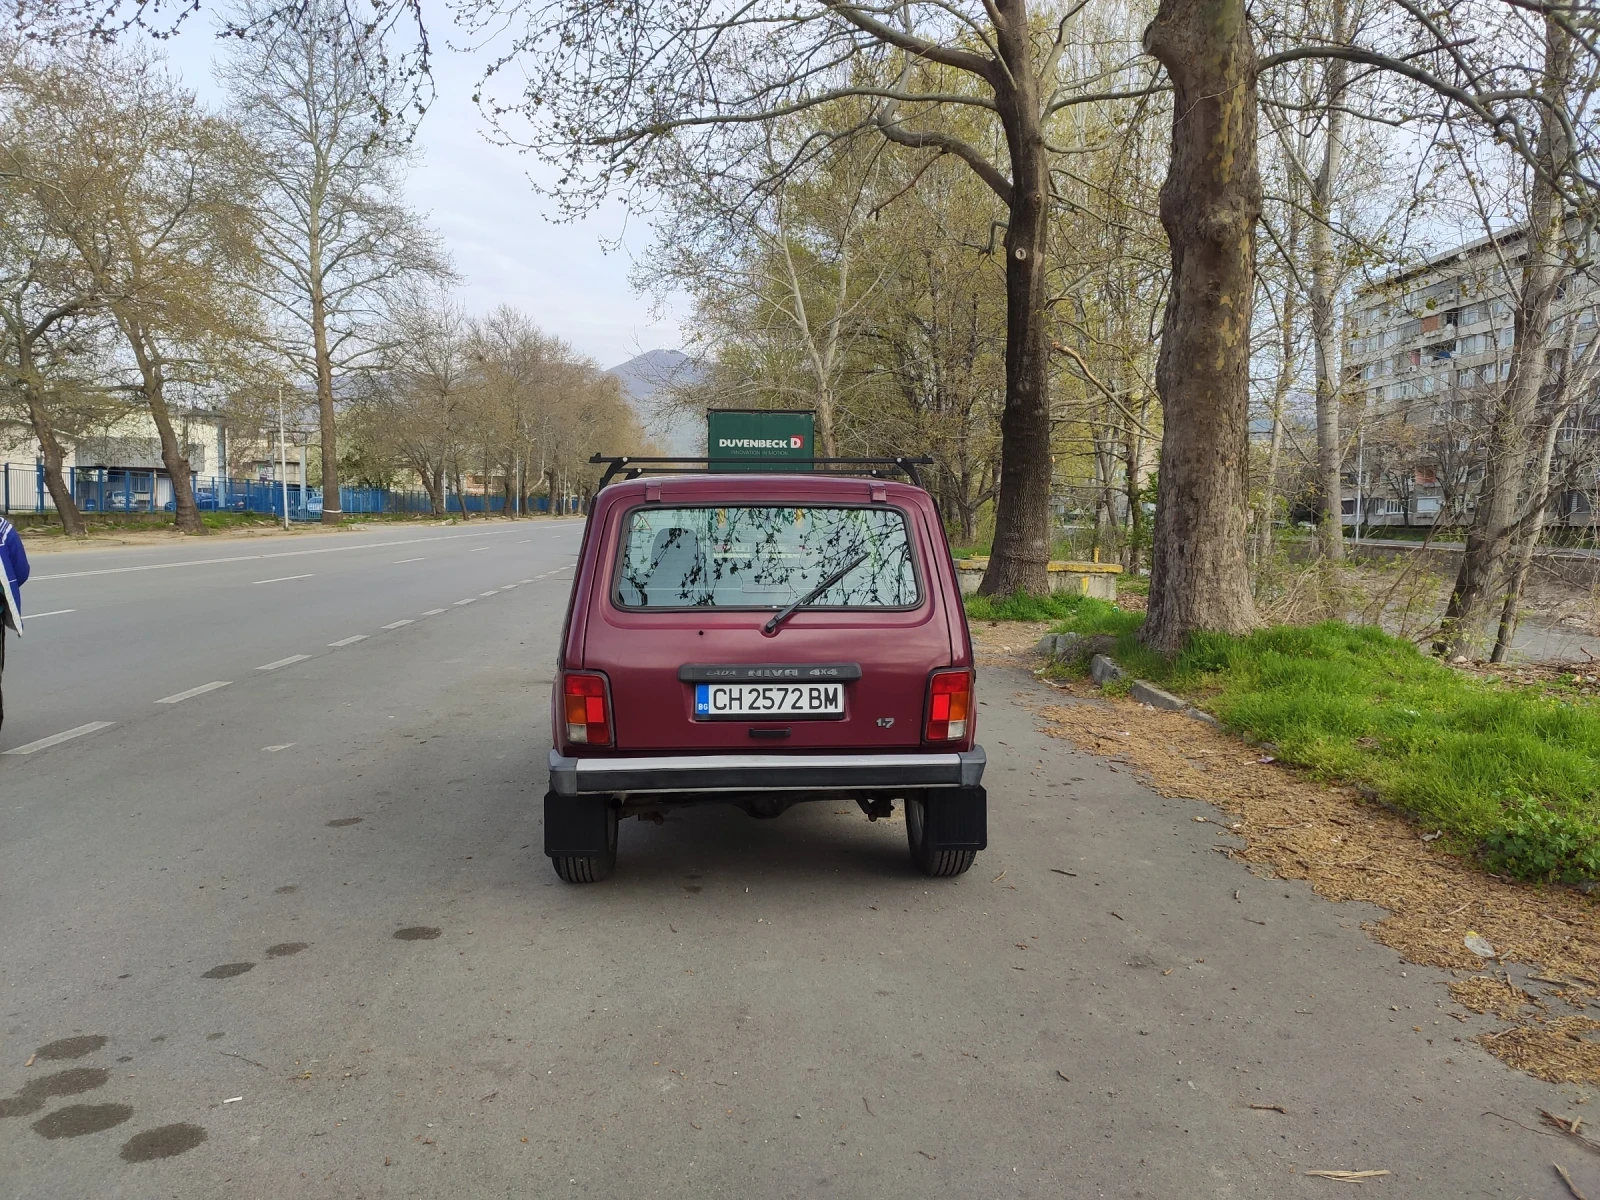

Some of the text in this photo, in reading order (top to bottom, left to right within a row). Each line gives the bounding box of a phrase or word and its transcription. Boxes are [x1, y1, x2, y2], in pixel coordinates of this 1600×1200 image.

[718, 438, 788, 449] DUVENBECK
[748, 669, 798, 677] NIVA
[698, 703, 709, 711] BG
